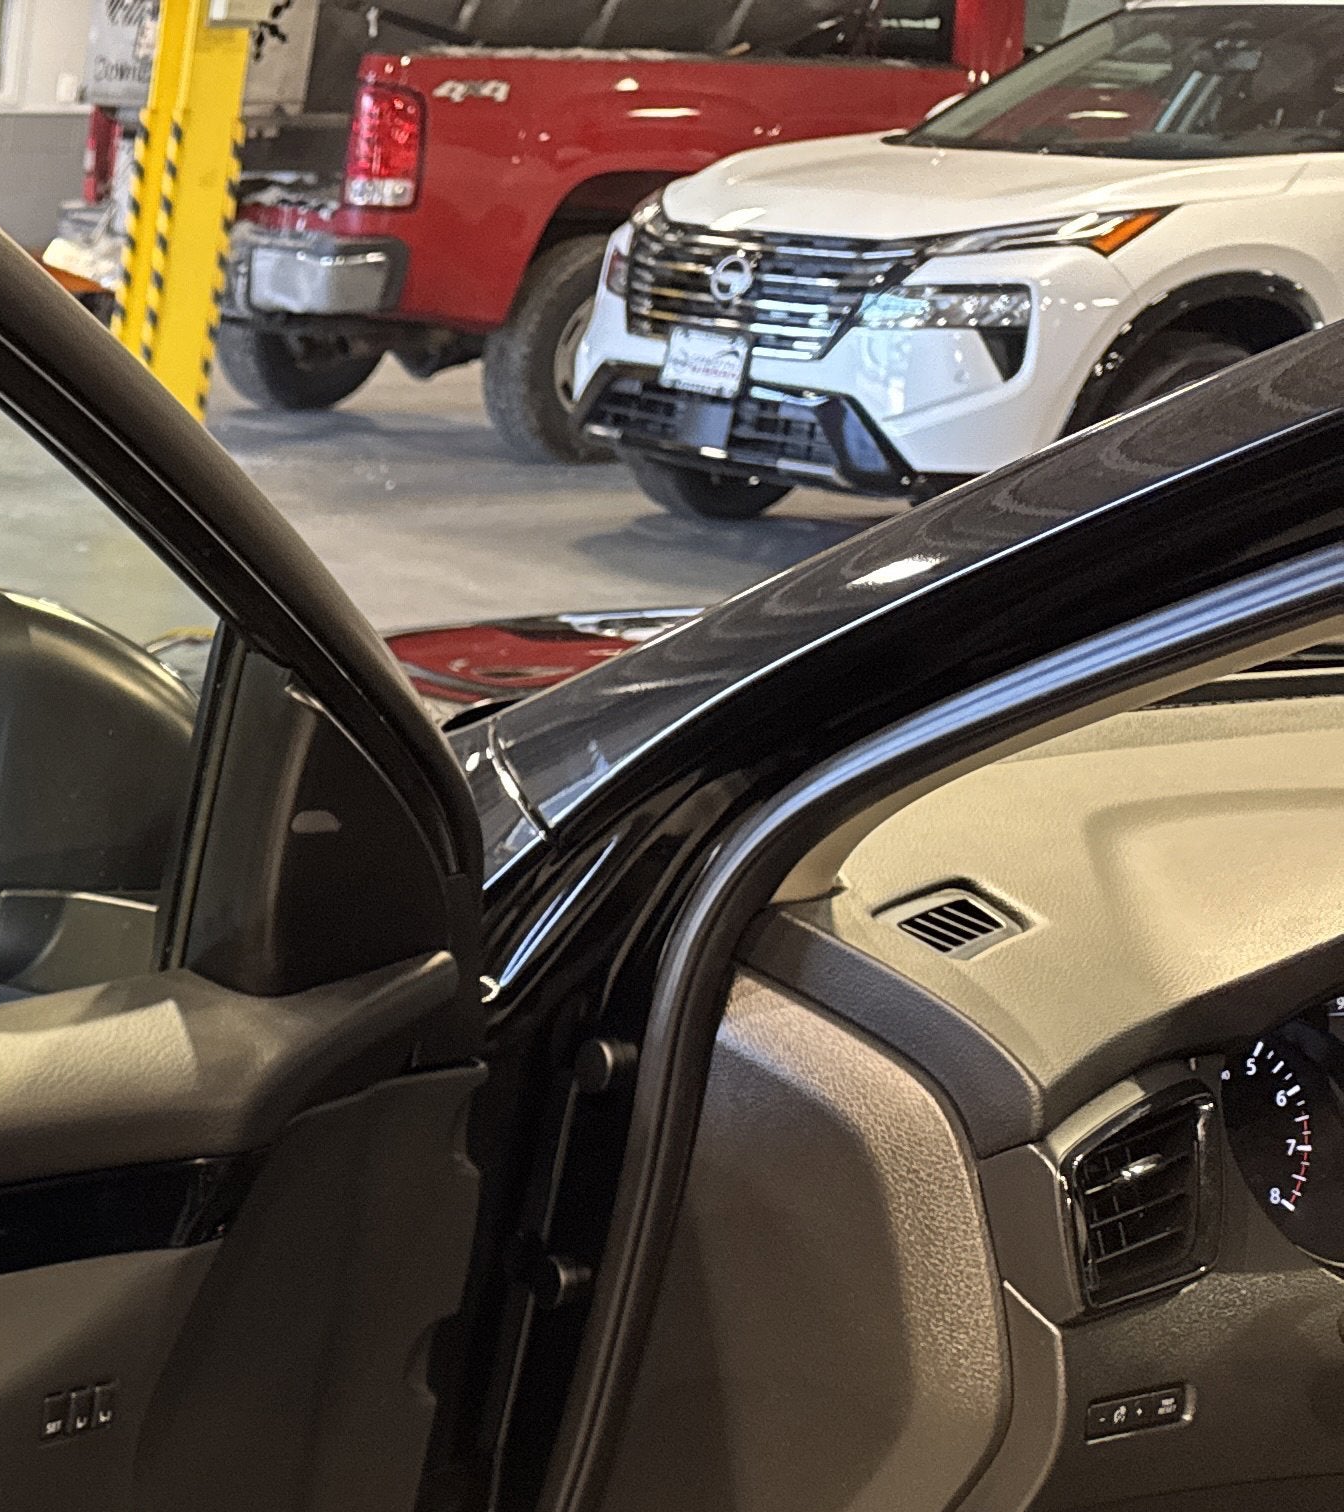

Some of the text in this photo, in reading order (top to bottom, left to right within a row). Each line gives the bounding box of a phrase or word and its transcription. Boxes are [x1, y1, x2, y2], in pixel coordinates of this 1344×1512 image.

[1246, 1057, 1257, 1076] 5
[1275, 1089, 1288, 1108] 6
[1286, 1138, 1297, 1156] 7
[1268, 1187, 1281, 1205] 8
